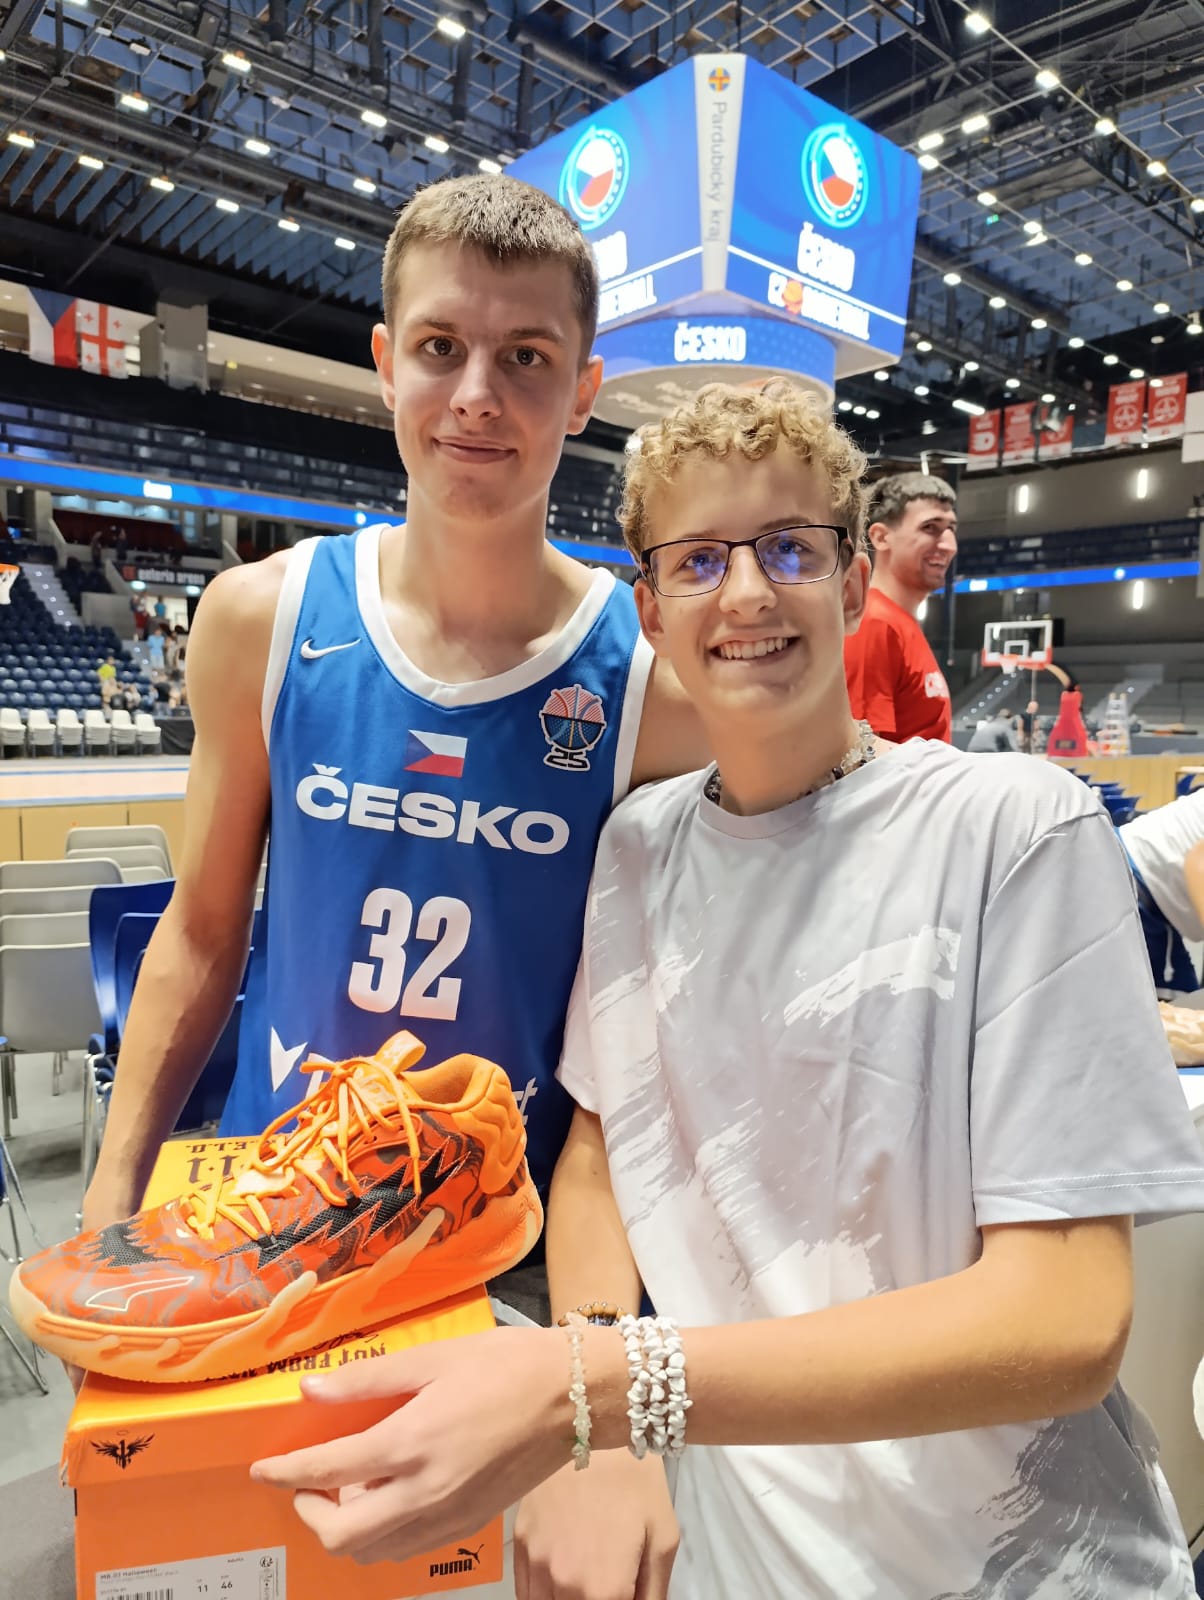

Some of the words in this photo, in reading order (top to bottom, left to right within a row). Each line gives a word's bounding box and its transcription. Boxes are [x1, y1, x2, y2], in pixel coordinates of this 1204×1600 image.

[704, 208, 724, 242] kraj
[674, 321, 747, 362] ČESKO
[545, 747, 590, 770] 25
[296, 763, 570, 854] ČESKO
[347, 887, 472, 1021] 32
[429, 1558, 473, 1578] PUMA
[197, 1584, 208, 1593] 11
[220, 1580, 233, 1590] 46
